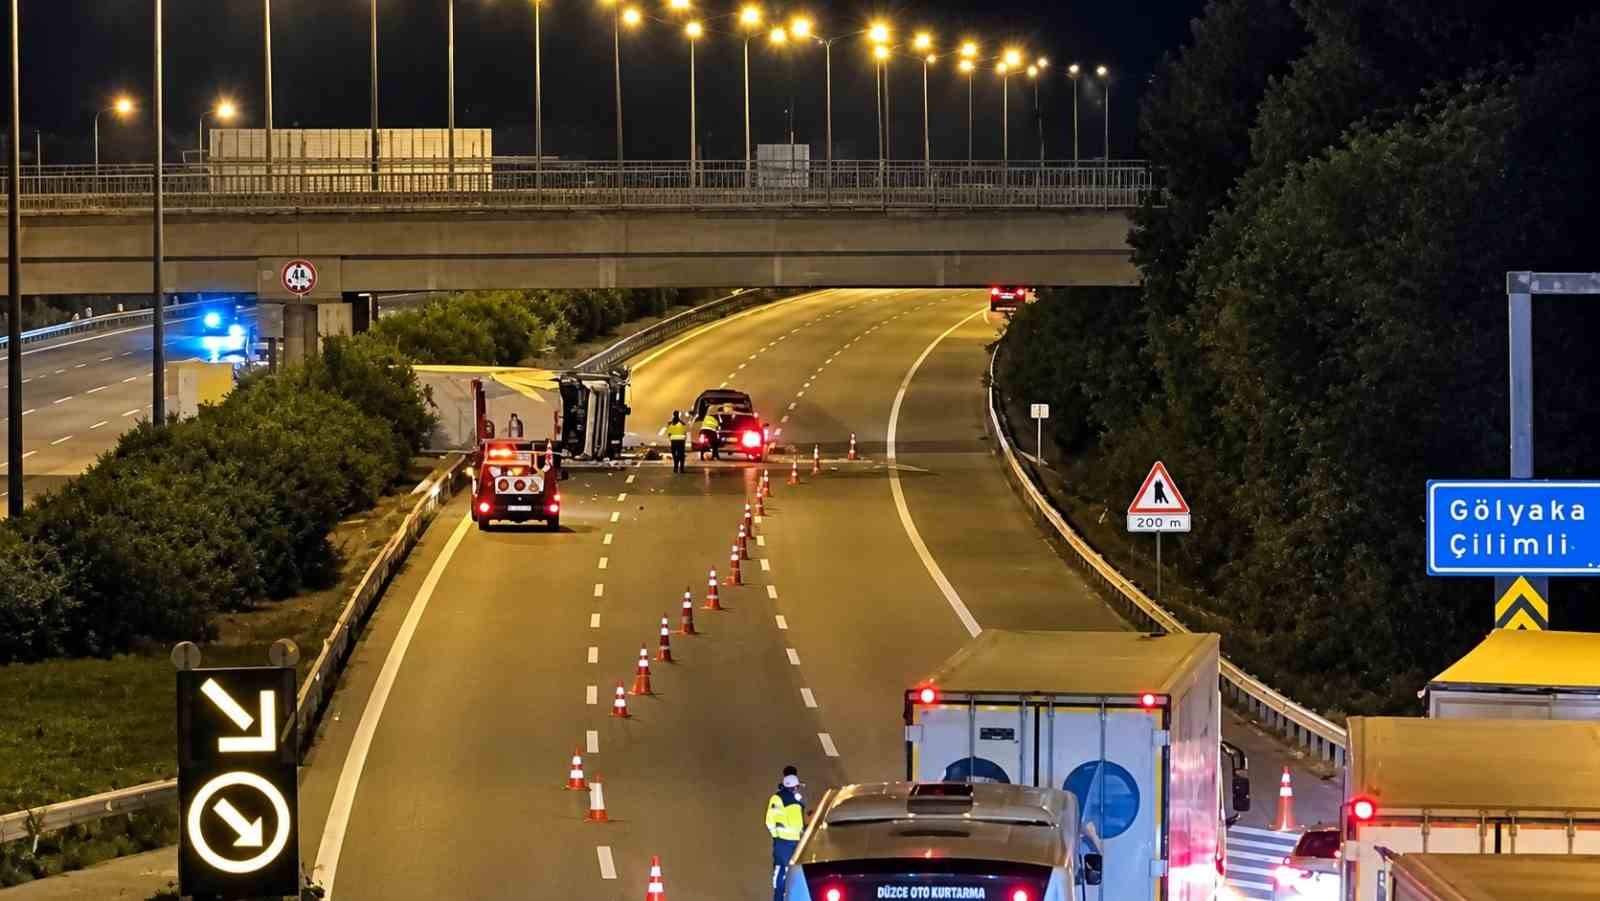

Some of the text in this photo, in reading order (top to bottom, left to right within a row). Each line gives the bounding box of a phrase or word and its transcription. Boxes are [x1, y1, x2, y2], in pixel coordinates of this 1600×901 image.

[1450, 499, 1585, 526] Gölyaka
[1137, 518, 1163, 528] 200
[1450, 533, 1568, 559] Çilimli
[877, 885, 986, 900] DÜZCE OTO KURTARMA
